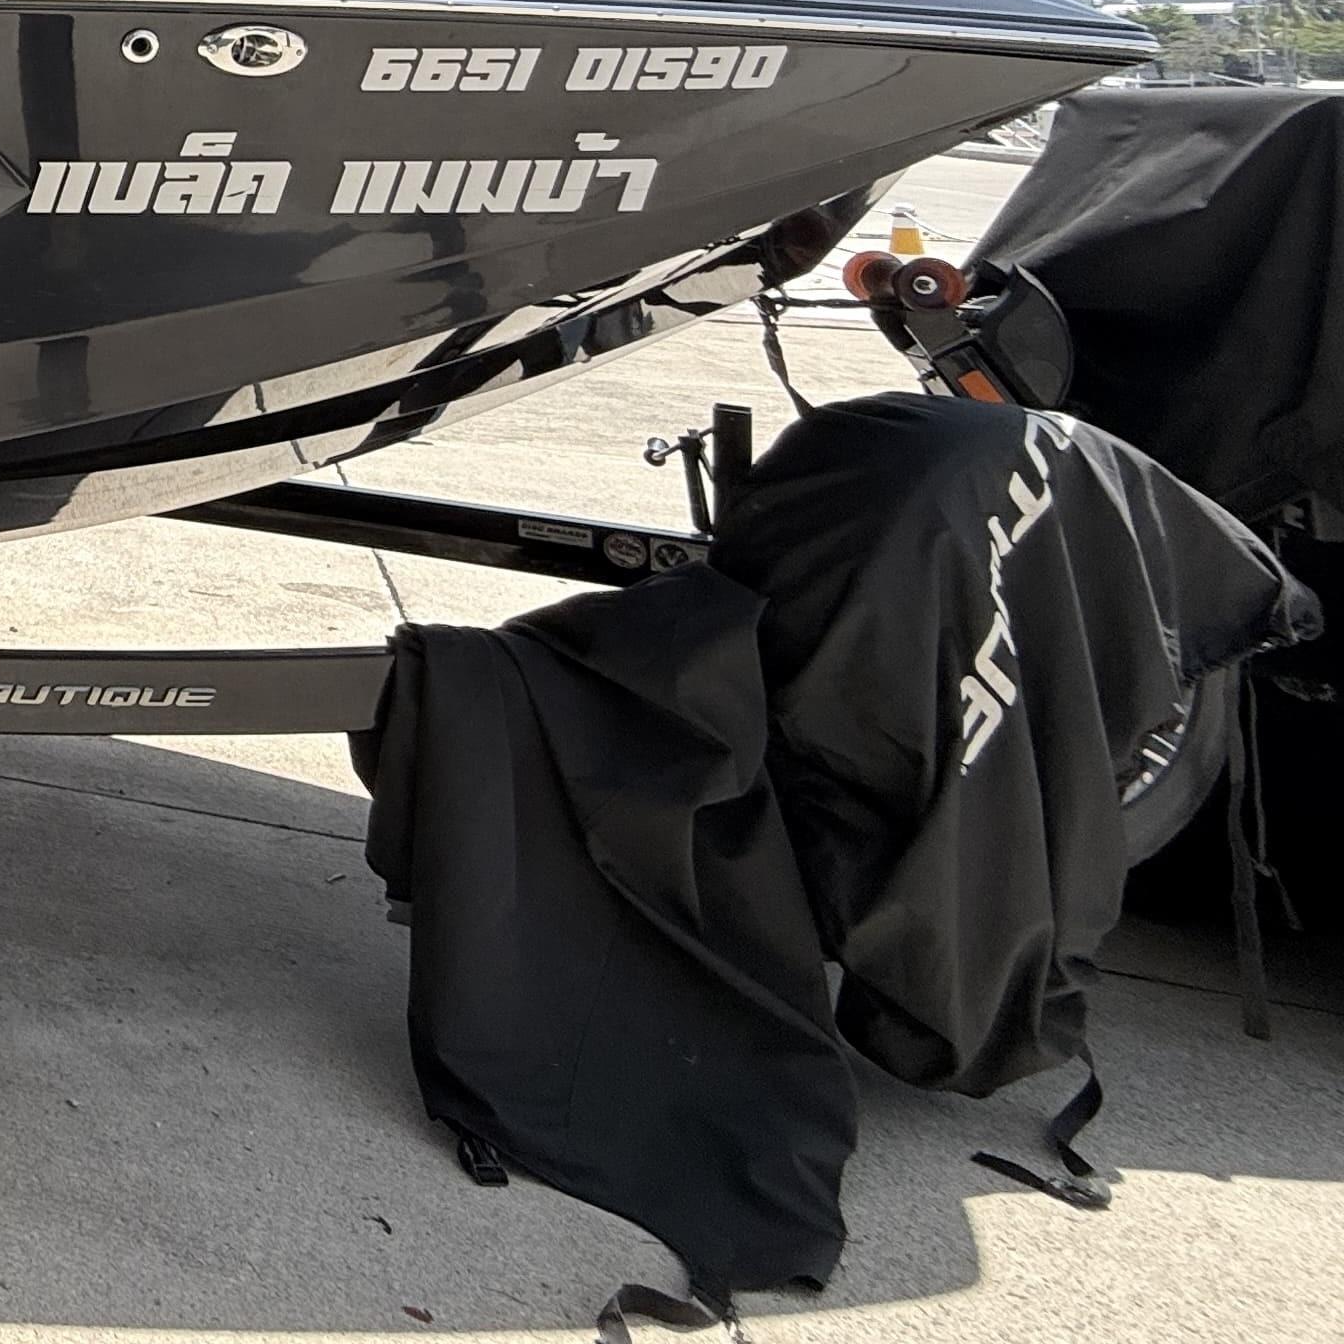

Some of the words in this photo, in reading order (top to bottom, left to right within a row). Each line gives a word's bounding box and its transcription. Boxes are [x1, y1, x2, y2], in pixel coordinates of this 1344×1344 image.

[360, 47, 542, 92] 6651
[565, 45, 788, 92] 01590
[25, 131, 293, 214] แบล็ค
[329, 132, 658, 214] แมมบ้า
